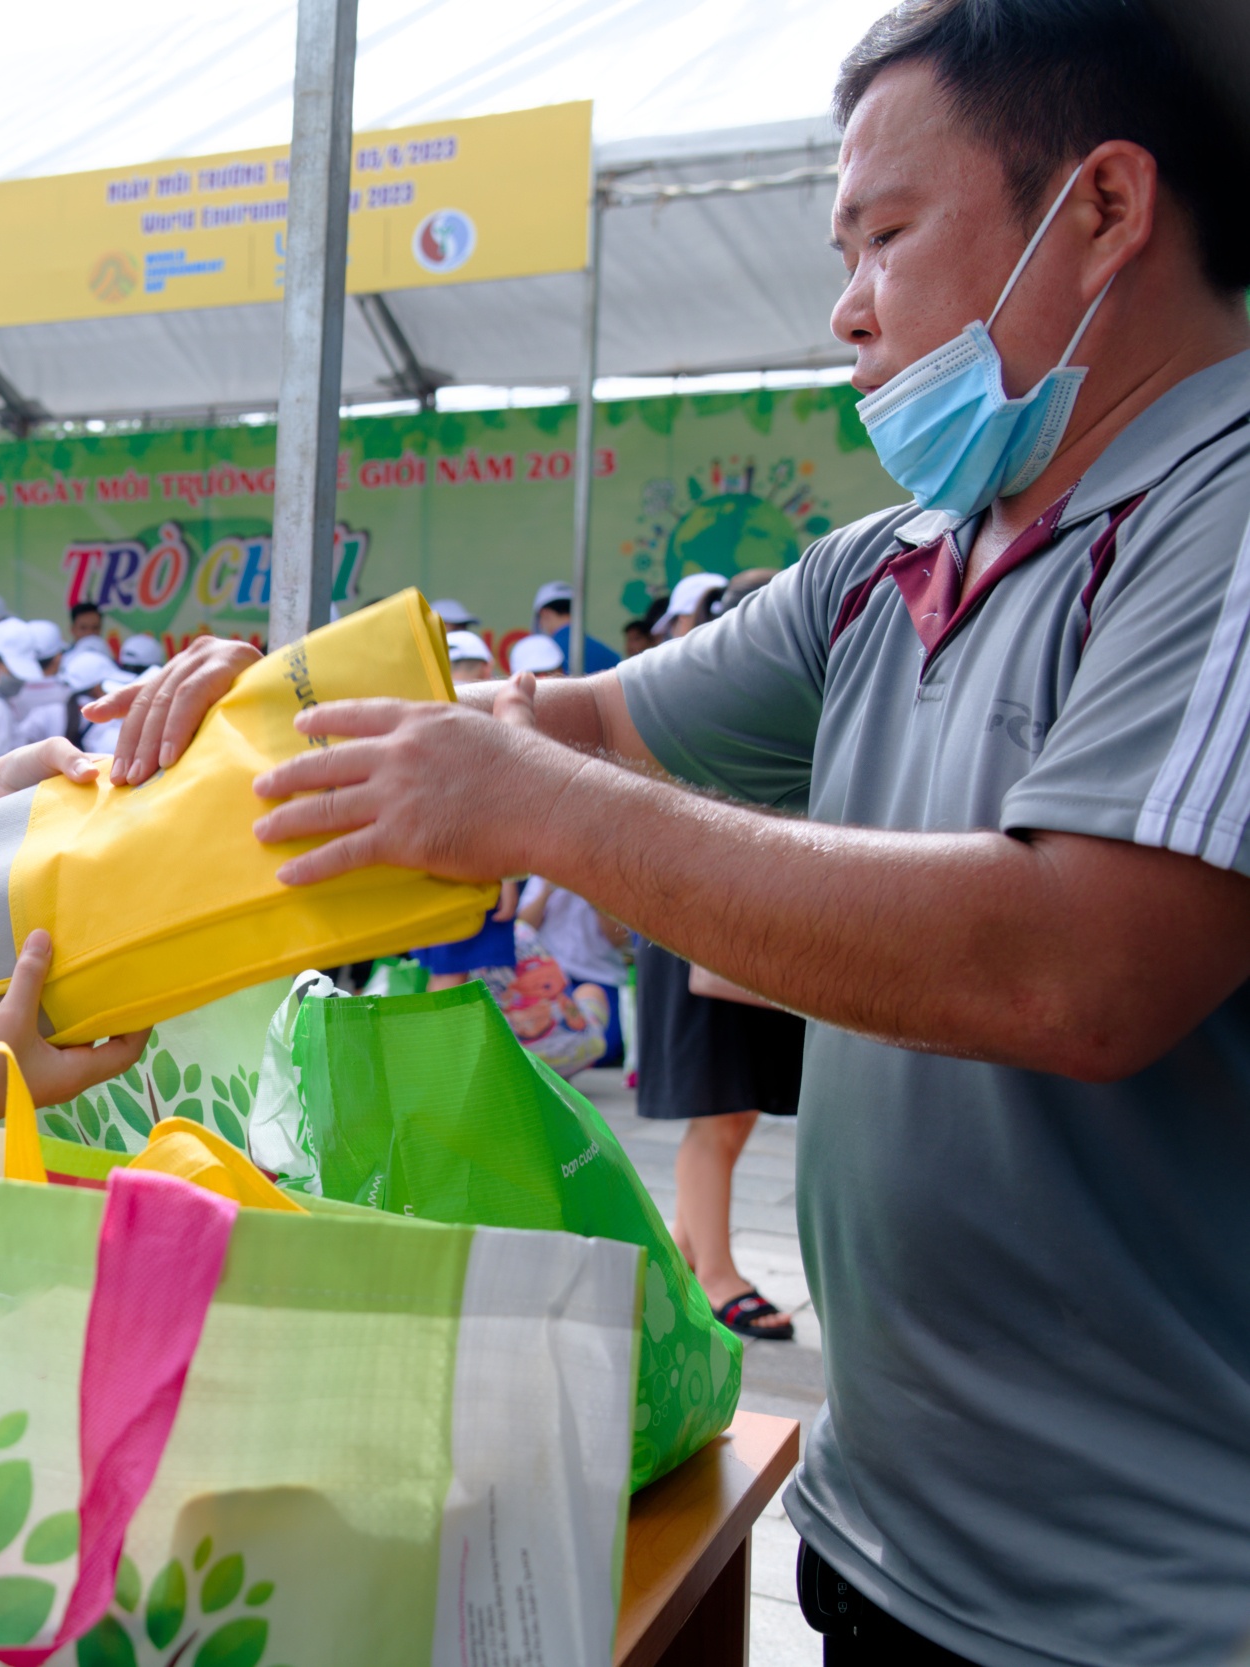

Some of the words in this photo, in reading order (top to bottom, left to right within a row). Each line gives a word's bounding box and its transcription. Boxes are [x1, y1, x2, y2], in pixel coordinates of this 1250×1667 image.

[202, 201, 290, 229] Environm
[96, 466, 150, 502] MÔI
[525, 448, 617, 480] 203
[62, 524, 187, 610] TRÒ
[196, 530, 363, 606] CHI
